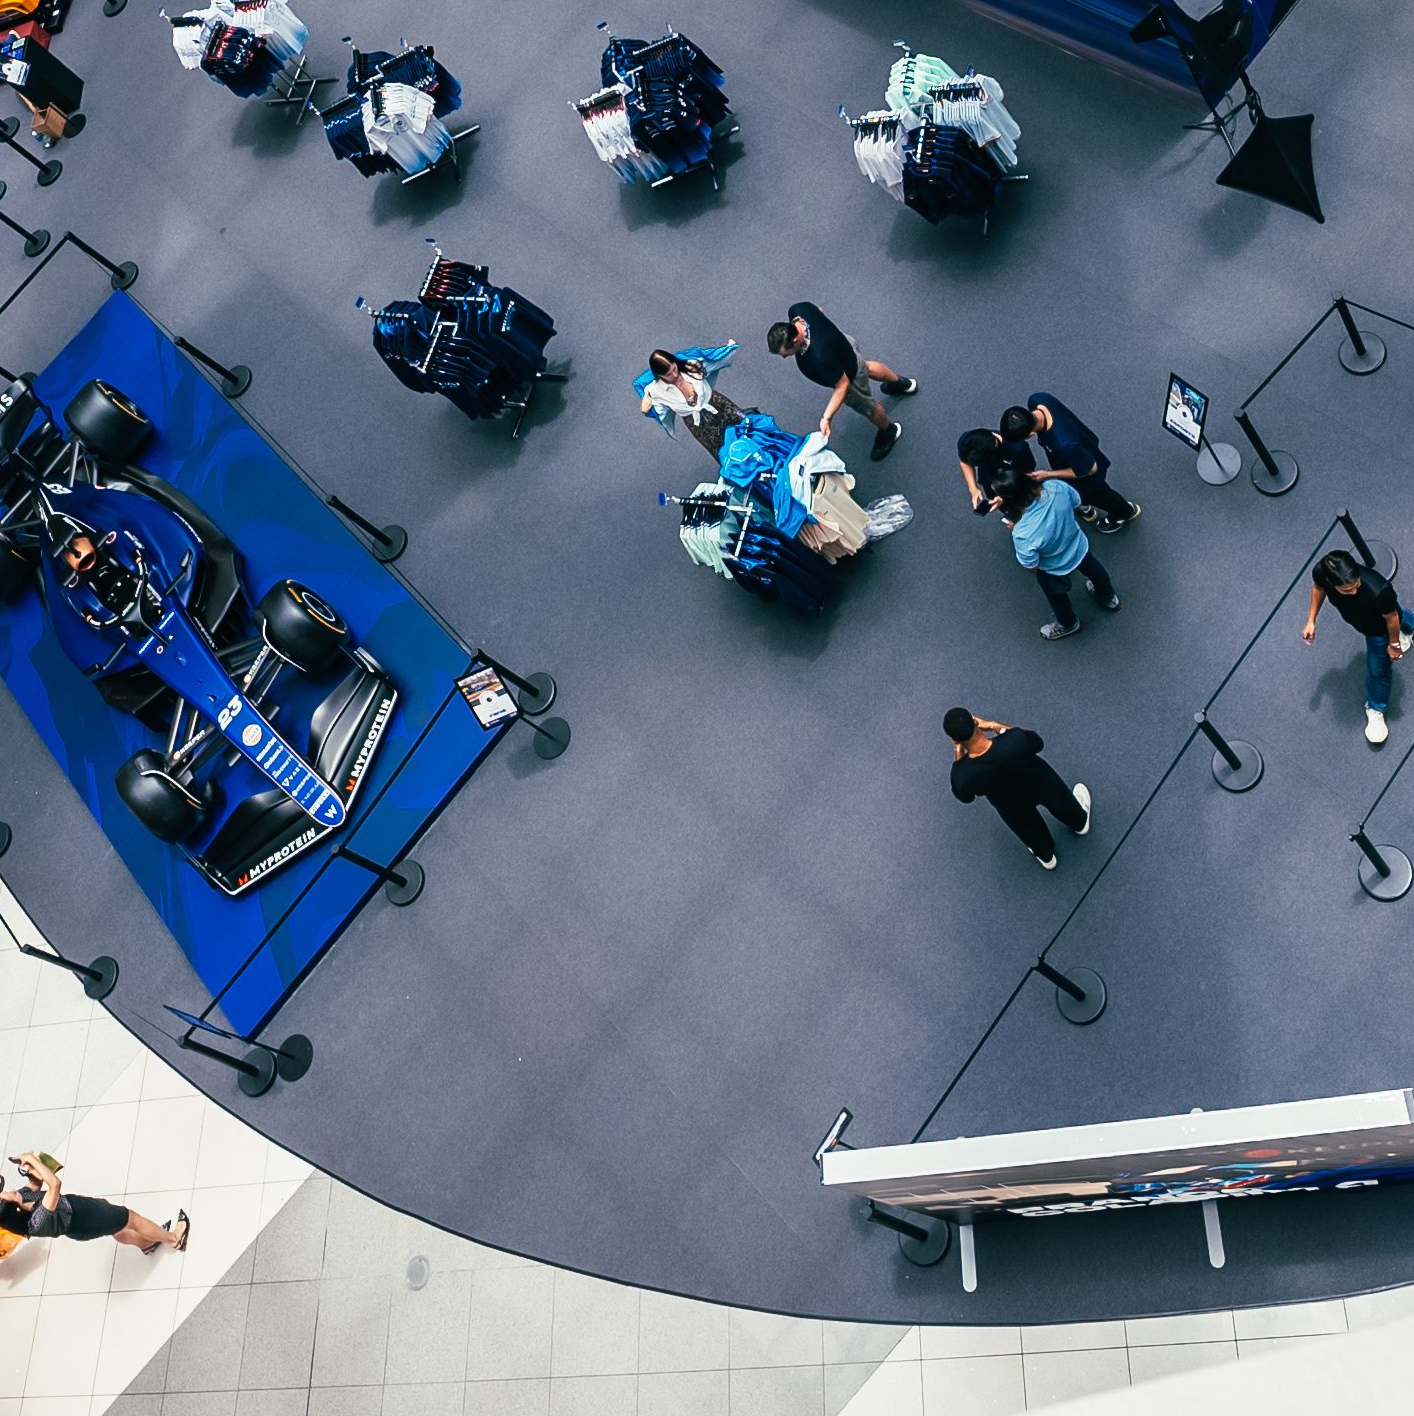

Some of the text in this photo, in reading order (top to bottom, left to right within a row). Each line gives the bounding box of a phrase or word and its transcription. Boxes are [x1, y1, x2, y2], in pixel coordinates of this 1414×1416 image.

[217, 694, 243, 732] 23
[350, 698, 391, 778] MYPROTEIN
[248, 827, 317, 879] MYPROTEIN
